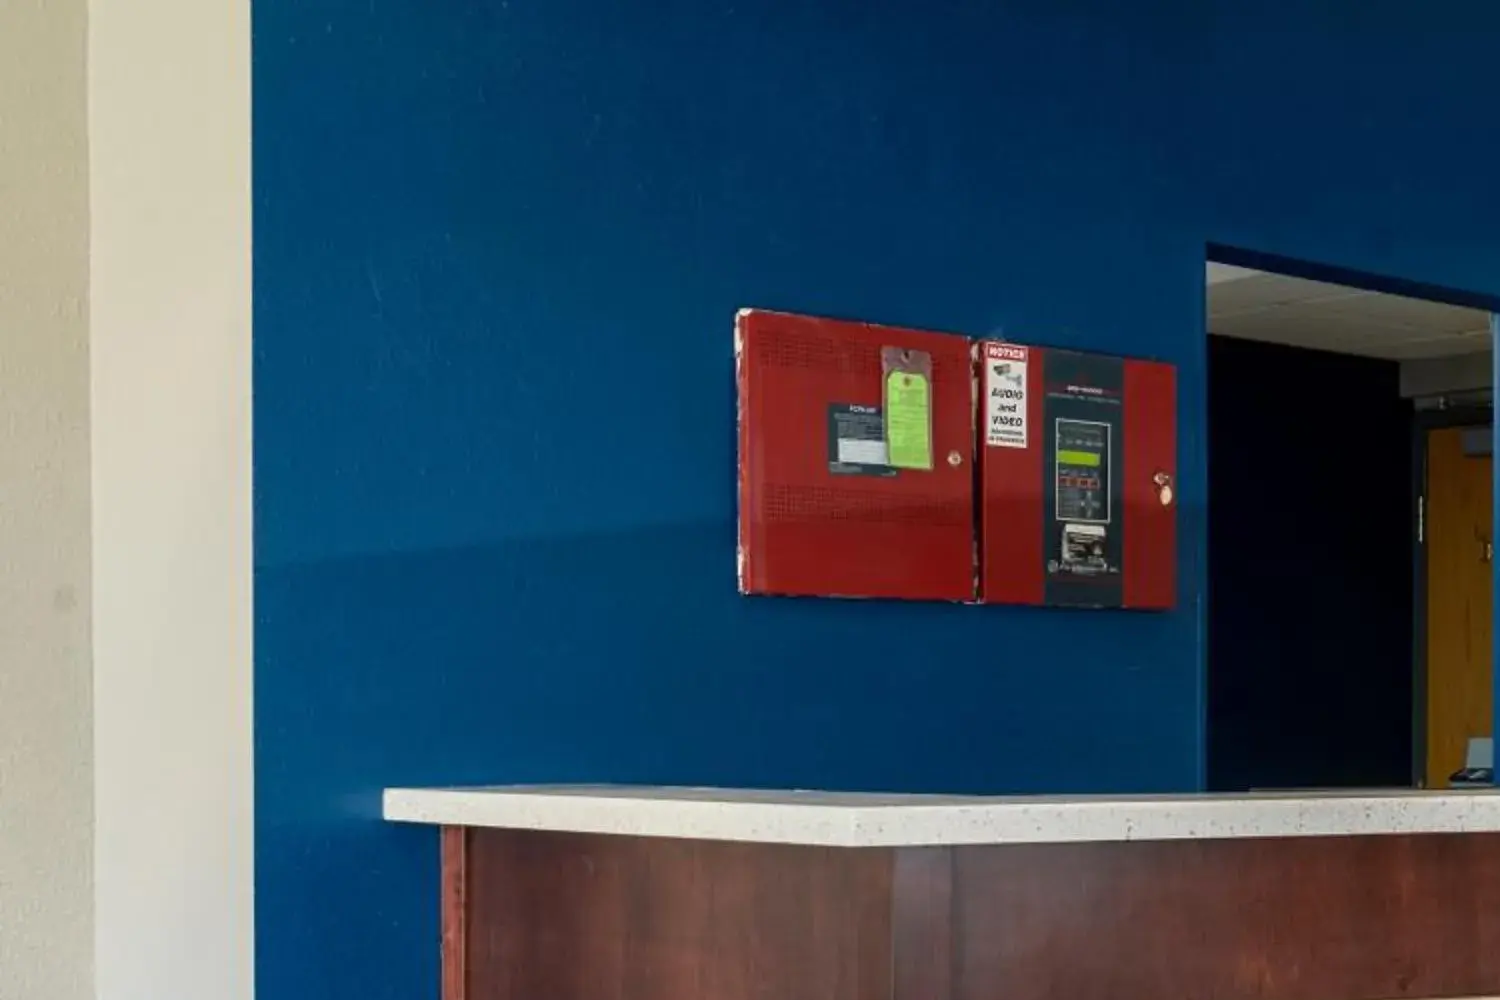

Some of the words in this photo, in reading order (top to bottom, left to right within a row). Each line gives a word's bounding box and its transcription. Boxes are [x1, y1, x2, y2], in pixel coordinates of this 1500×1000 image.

[989, 347, 1024, 358] NOTICE
[991, 388, 1023, 400] AUDIO
[998, 404, 1017, 412] and
[991, 416, 1023, 426] VIDEO
